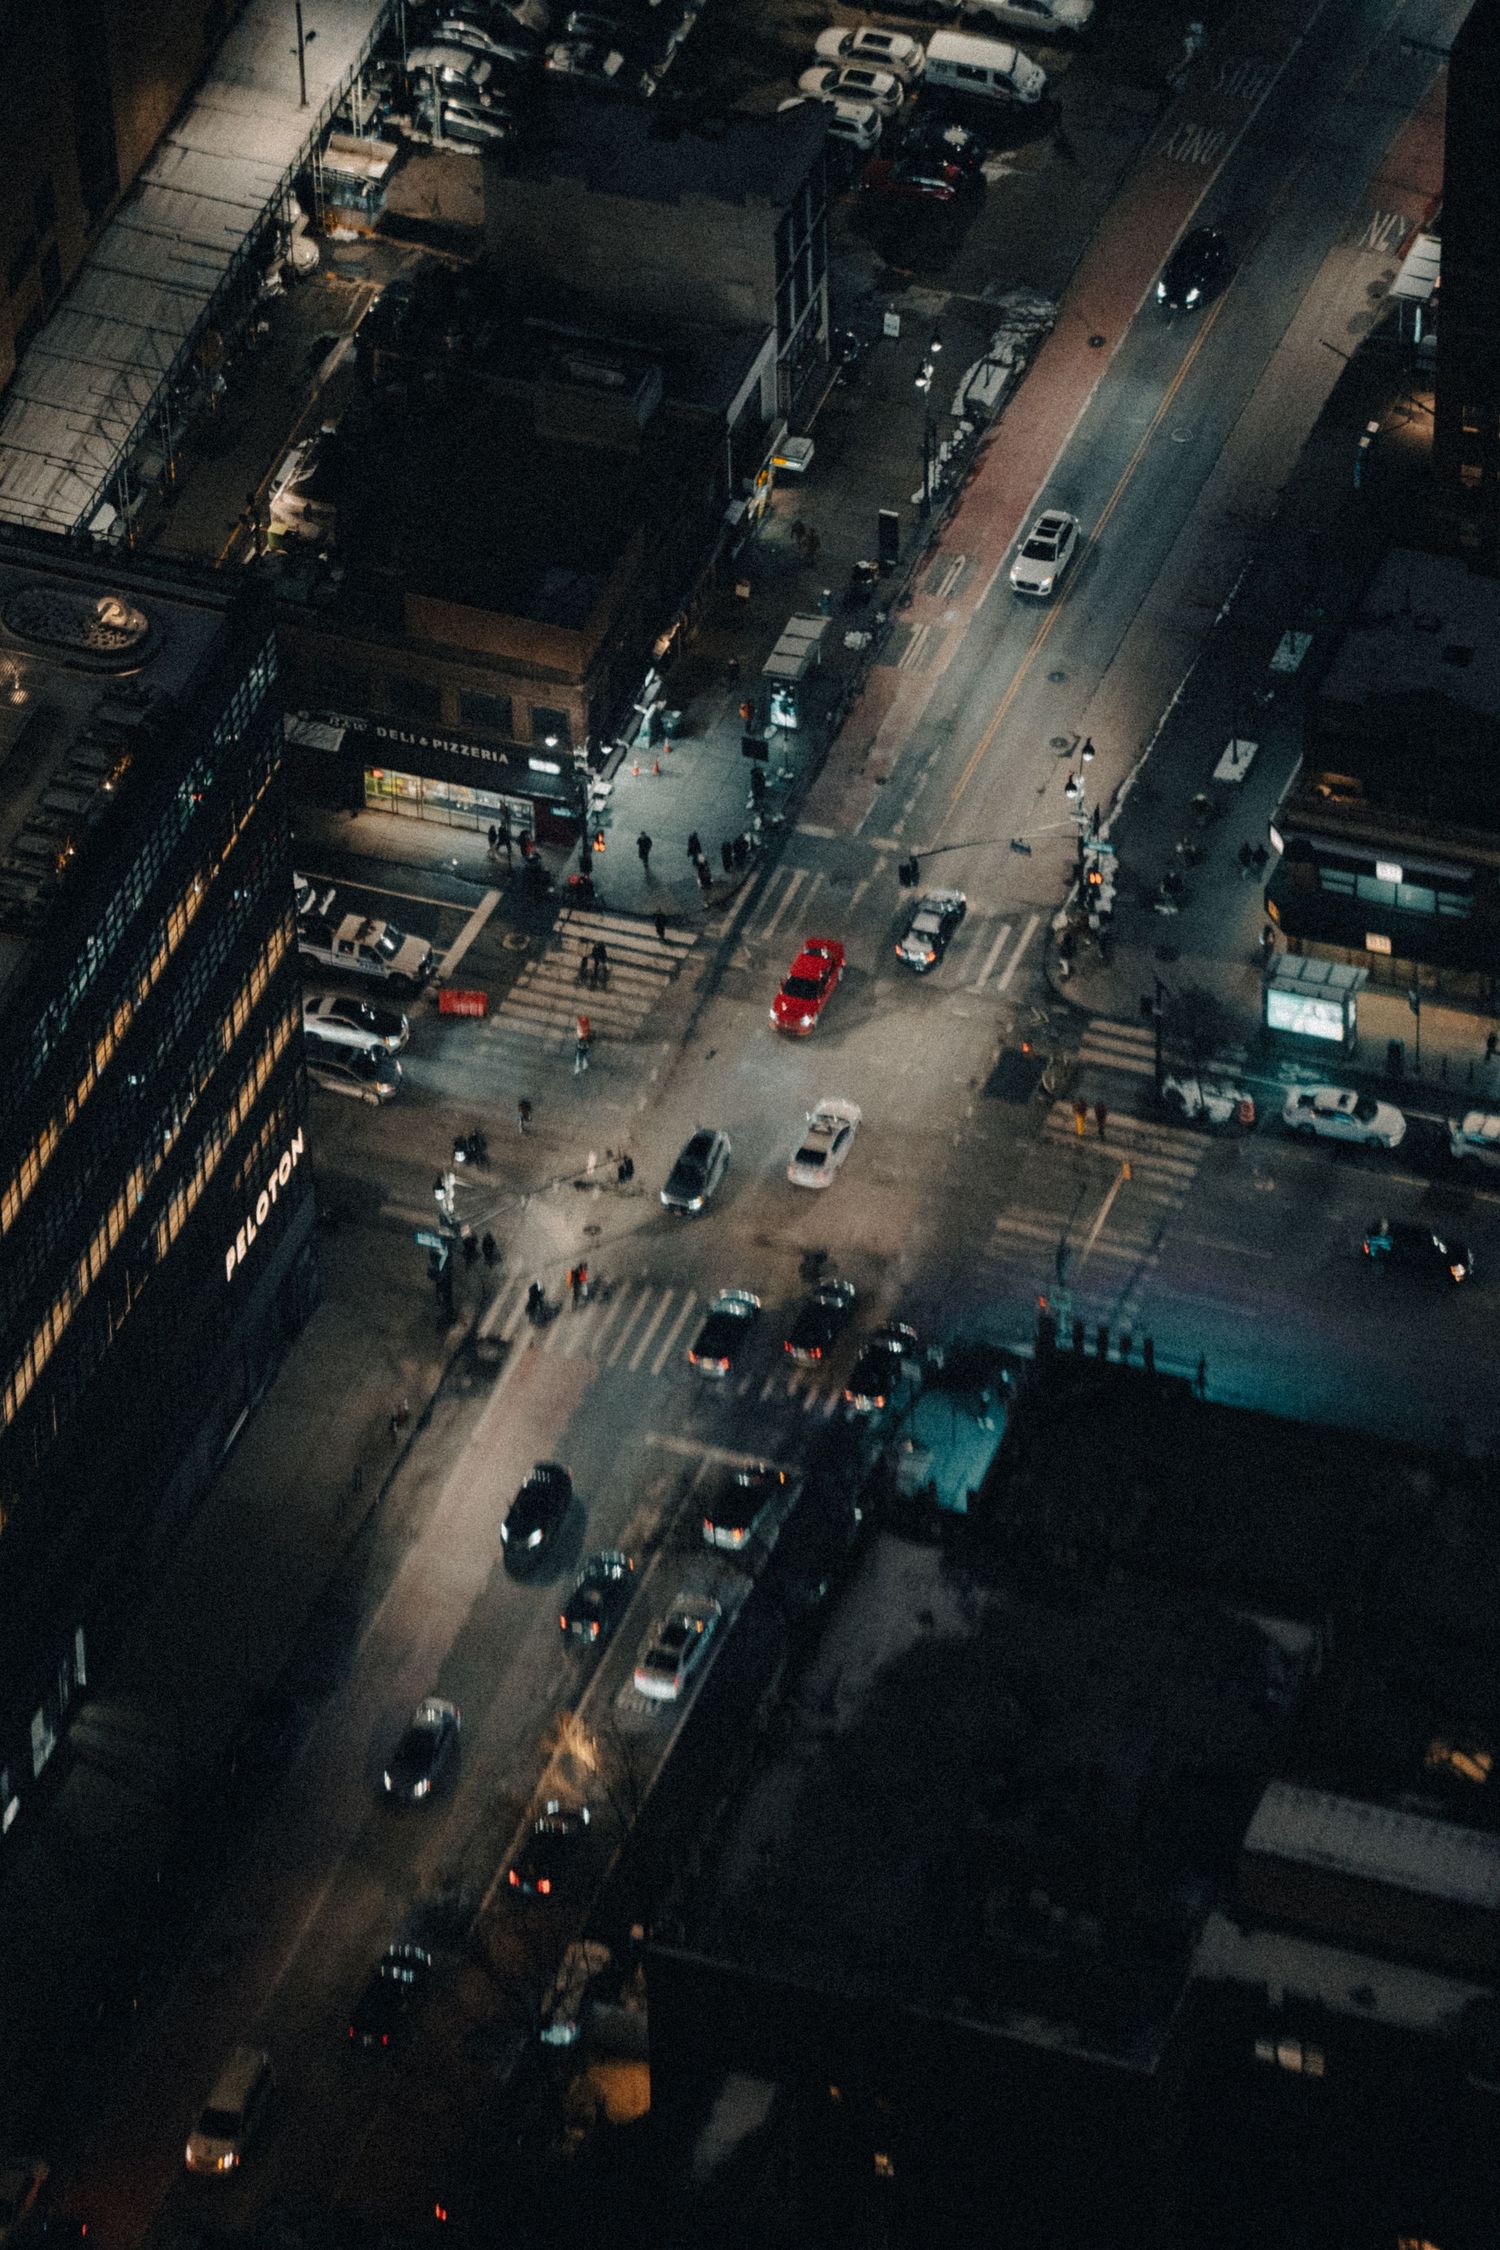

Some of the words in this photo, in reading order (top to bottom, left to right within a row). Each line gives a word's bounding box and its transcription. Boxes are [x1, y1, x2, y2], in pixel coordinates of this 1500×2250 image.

[376, 727, 415, 744] DELI
[432, 739, 508, 764] PIZZERIA
[225, 1125, 305, 1283] PELOTON
